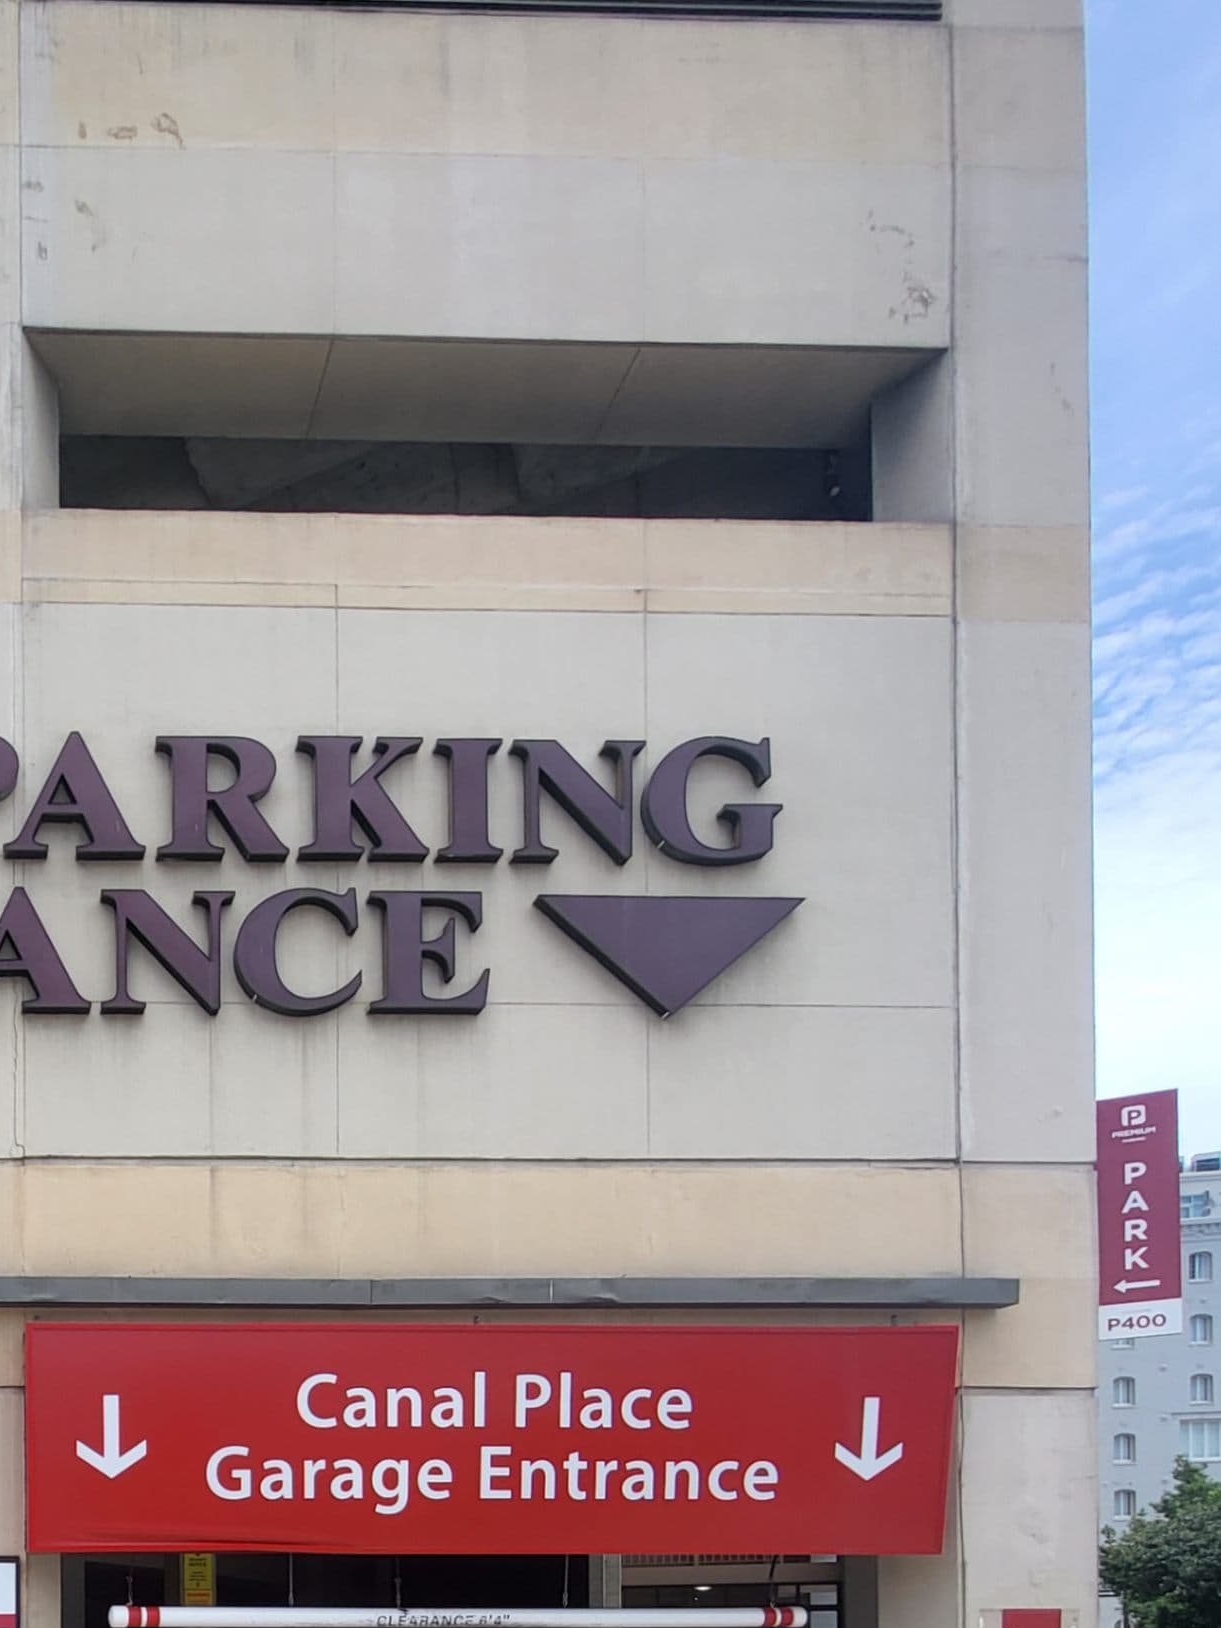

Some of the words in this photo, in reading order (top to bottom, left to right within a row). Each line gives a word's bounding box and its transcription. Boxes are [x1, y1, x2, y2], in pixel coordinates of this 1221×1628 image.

[1121, 1161, 1149, 1271] PARK
[1107, 1313, 1167, 1332] P400
[296, 1371, 487, 1429] Canal
[514, 1371, 693, 1429] Place
[205, 1446, 454, 1515] Garage
[478, 1446, 780, 1502] Entrance
[376, 1614, 475, 1627] CLEARANCE
